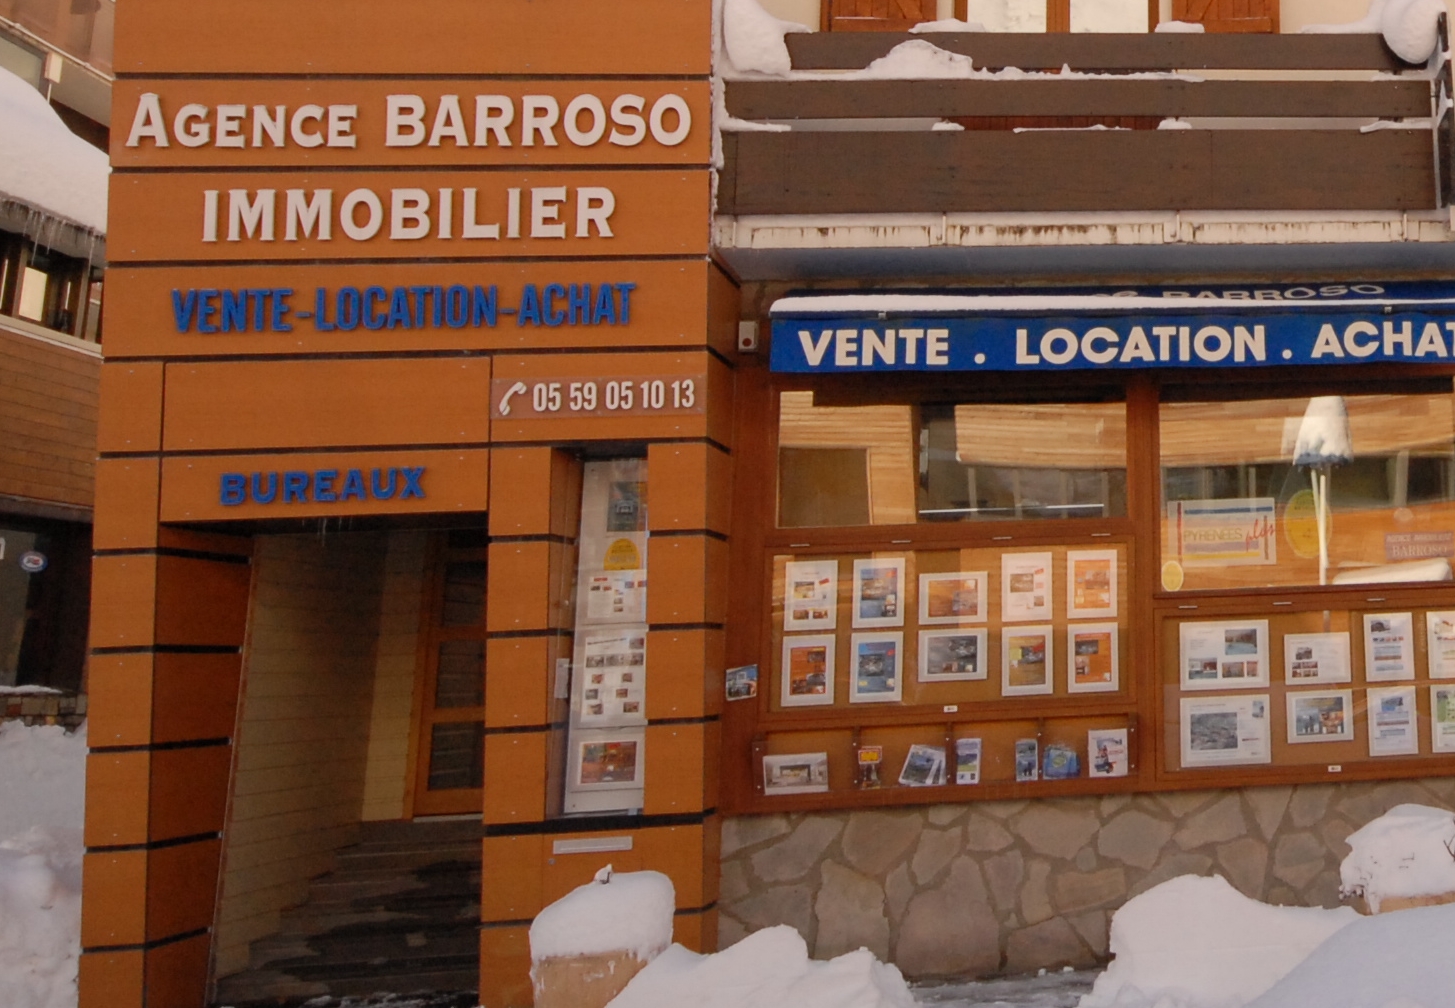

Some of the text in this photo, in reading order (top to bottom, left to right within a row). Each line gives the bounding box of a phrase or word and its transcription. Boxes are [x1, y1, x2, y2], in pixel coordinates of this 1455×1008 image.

[384, 93, 692, 147] BARROSO
[201, 186, 616, 243] IMMOBILIER
[798, 328, 950, 367] VENTE
[1014, 324, 1267, 365] LOCATION
[533, 379, 695, 412] 05 59 05 10 13
[219, 466, 426, 506] BUREAUX
